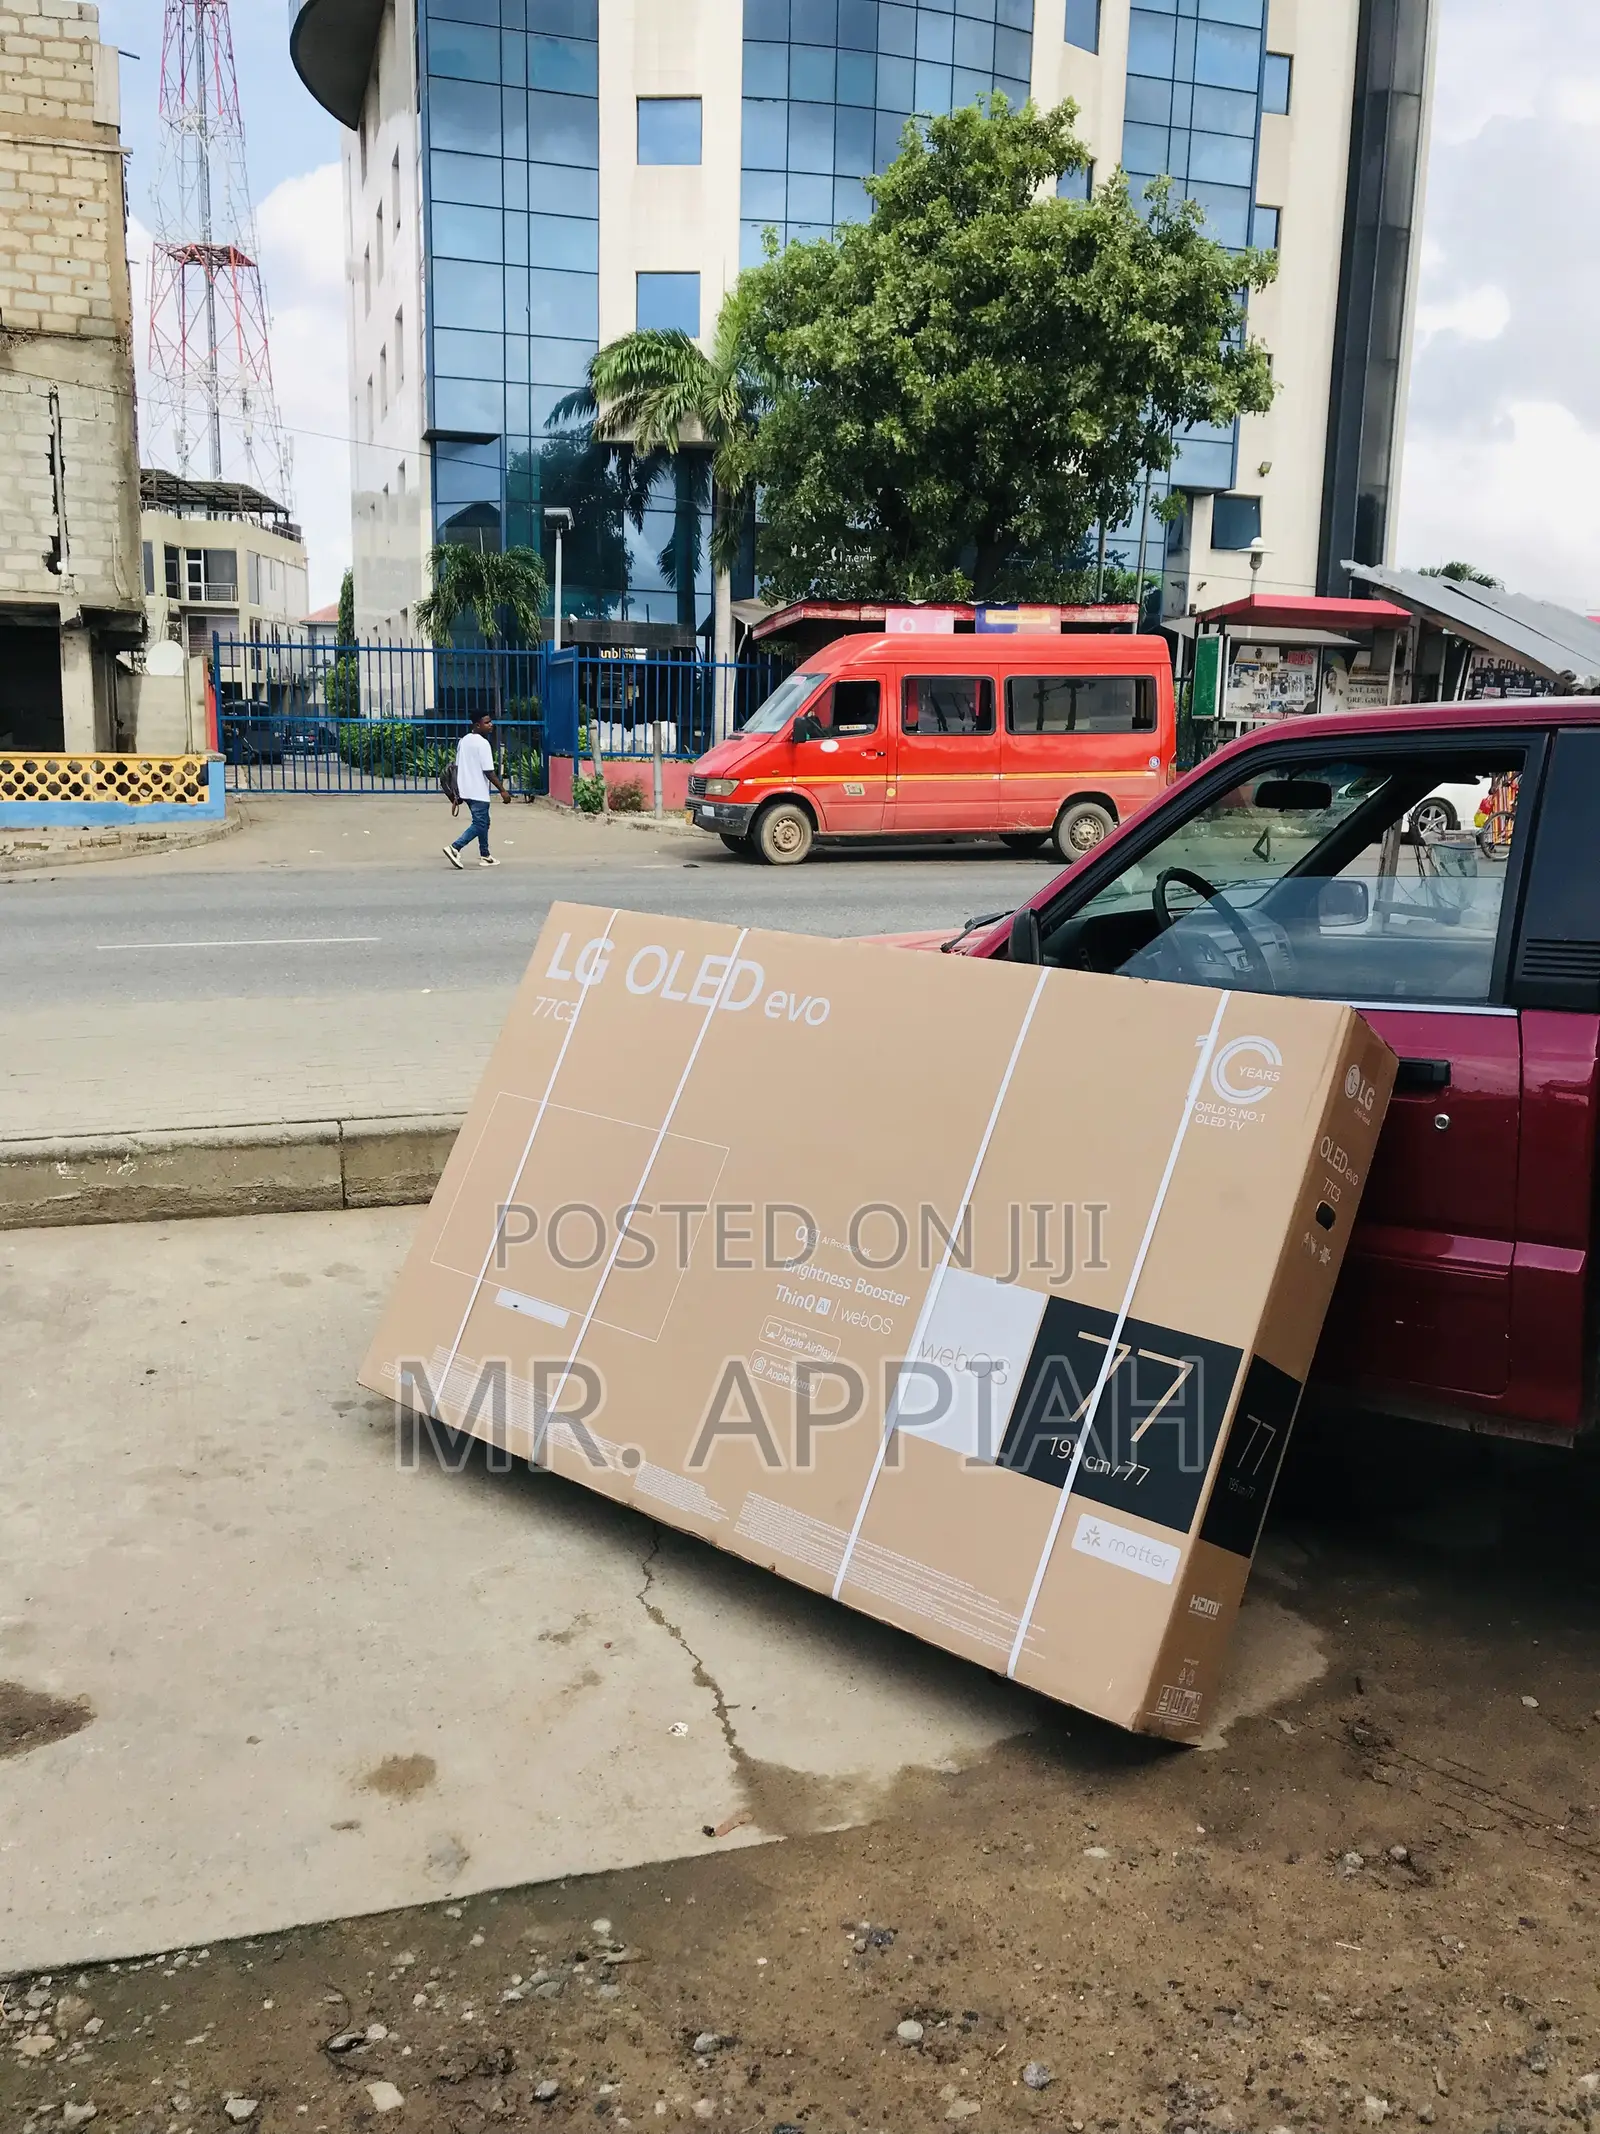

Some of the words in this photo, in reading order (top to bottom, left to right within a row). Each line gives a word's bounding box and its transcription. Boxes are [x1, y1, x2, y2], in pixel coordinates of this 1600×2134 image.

[545, 932, 616, 985] LG
[625, 945, 764, 1011] OLED
[764, 990, 830, 1025] evo
[1239, 1066, 1281, 1082] YEARS
[1185, 1094, 1237, 1117] ORLD'S
[1239, 1110, 1266, 1123] NO.1
[1358, 1079, 1375, 1111] LG
[1195, 1113, 1226, 1128] OLED
[1229, 1119, 1245, 1131] TV
[1320, 1136, 1349, 1175] OLED
[1323, 1176, 1342, 1203] 77C3
[783, 1257, 852, 1290] Brightness
[855, 1277, 910, 1307] Booster
[776, 1284, 816, 1312] ThinQ
[841, 1307, 894, 1335] webOS
[780, 1332, 804, 1348] Apple
[804, 1340, 833, 1361] AirPlay
[918, 1341, 1010, 1385] webOS
[766, 1367, 790, 1384] Apple
[791, 1375, 815, 1392] Home
[1070, 1331, 1194, 1443] 77
[1237, 1413, 1276, 1475] 77
[1108, 1536, 1169, 1570] matter
